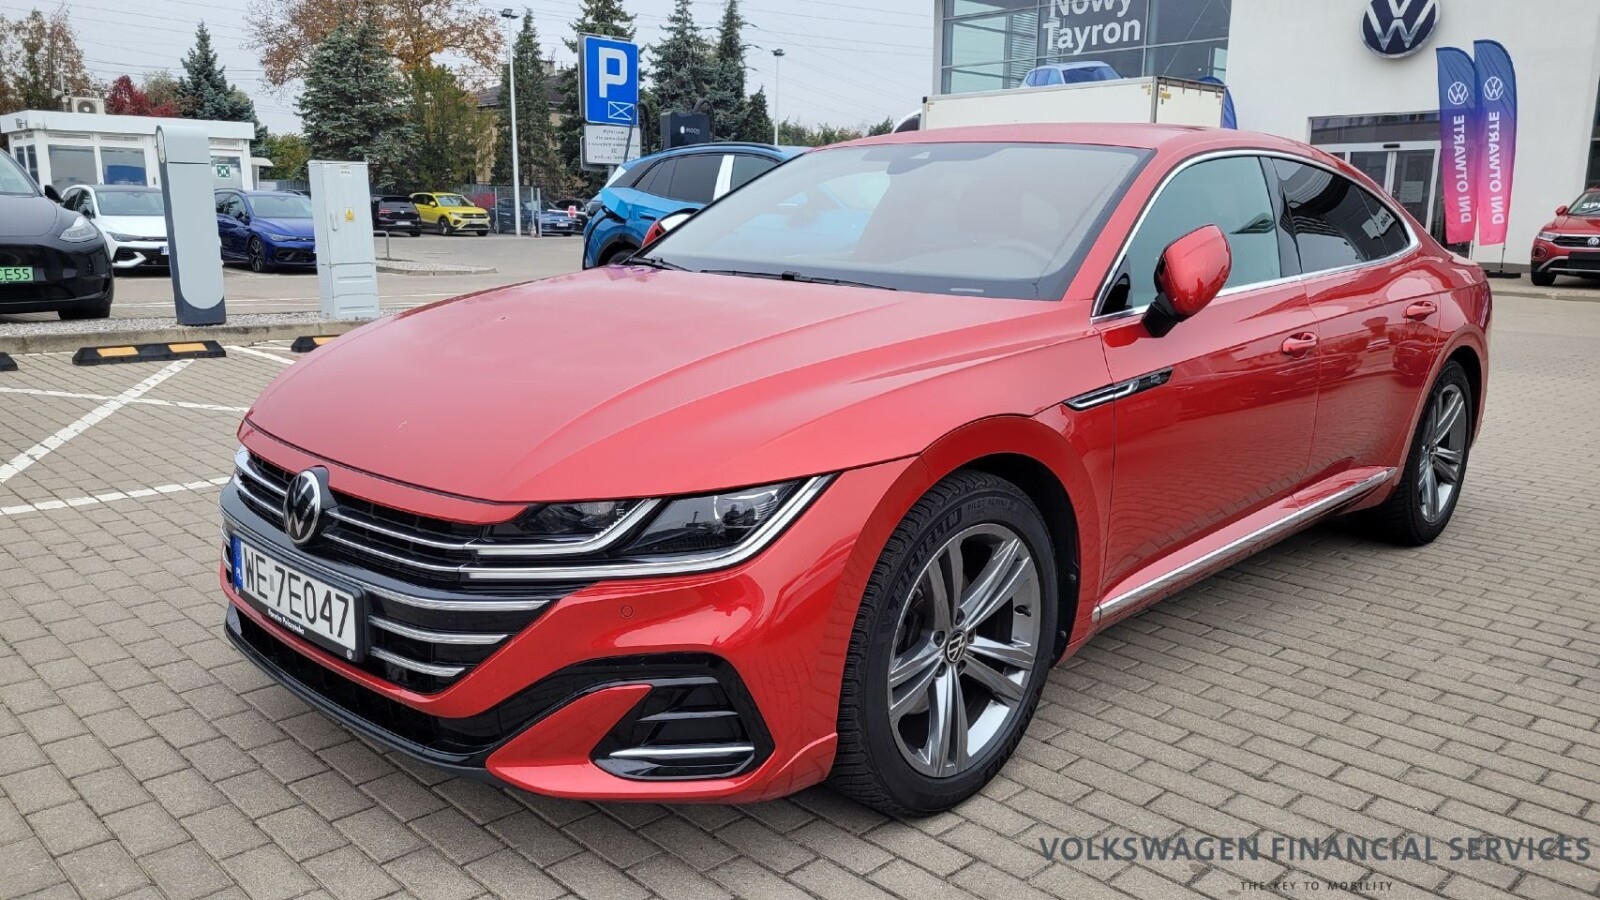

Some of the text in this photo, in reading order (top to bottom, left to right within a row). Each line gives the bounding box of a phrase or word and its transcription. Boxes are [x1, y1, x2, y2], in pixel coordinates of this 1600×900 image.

[1042, 19, 1141, 55] Tayron
[599, 47, 627, 98] P
[243, 547, 268, 600] WE
[275, 565, 350, 639] 7E047
